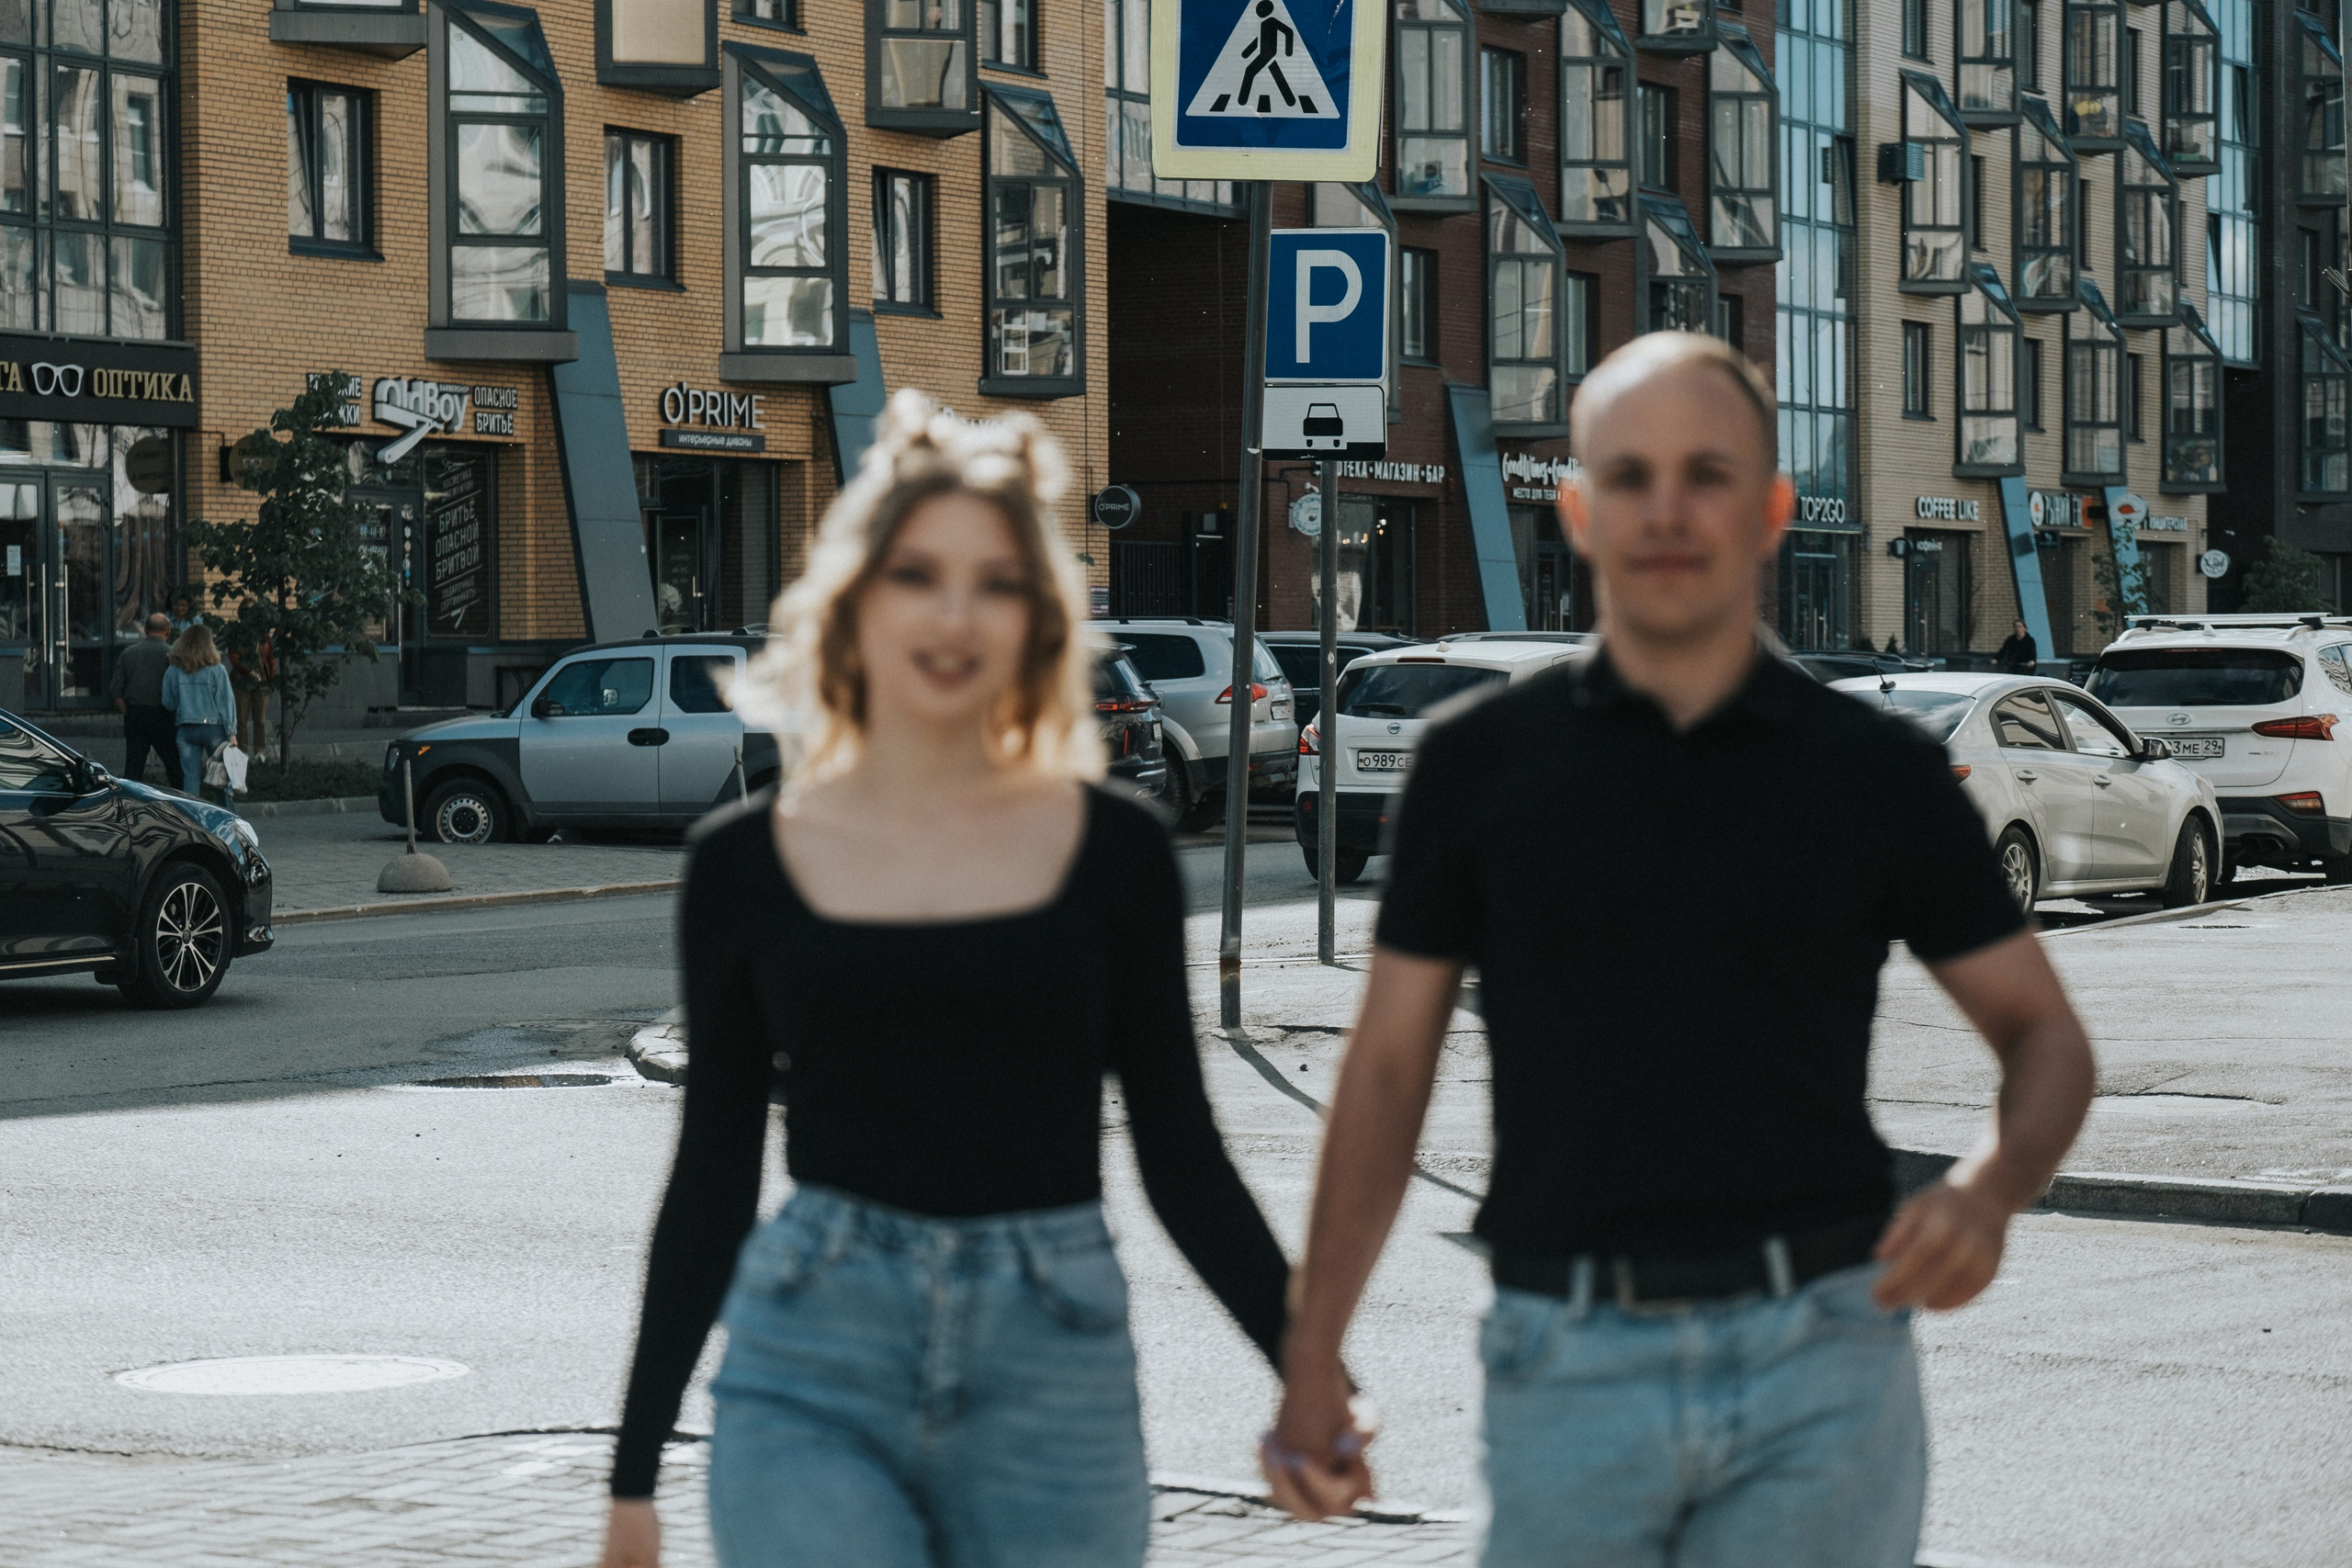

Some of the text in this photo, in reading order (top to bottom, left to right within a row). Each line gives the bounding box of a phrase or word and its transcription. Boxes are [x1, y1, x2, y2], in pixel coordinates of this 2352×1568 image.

[1295, 249, 1363, 364] P
[93, 368, 194, 402] ОПТИКА
[474, 387, 517, 408] ОПАСНОЕ
[663, 381, 766, 429] O'PRIME
[476, 412, 514, 434] БРИТЬЁ
[678, 434, 752, 446] интерьерные диваны
[1374, 461, 1419, 482] МАГАЗИН
[1425, 465, 1445, 483] БАР
[439, 497, 475, 534] БРИТЬЁ
[1098, 502, 1130, 512] O'PRIME
[1800, 496, 1846, 524] TOP2GO
[1917, 496, 1979, 521] COFFEE LIKE
[435, 518, 480, 558] ОПАСНОЙ
[435, 542, 480, 581] БРИТВОЙ
[2204, 739, 2218, 750] 29
